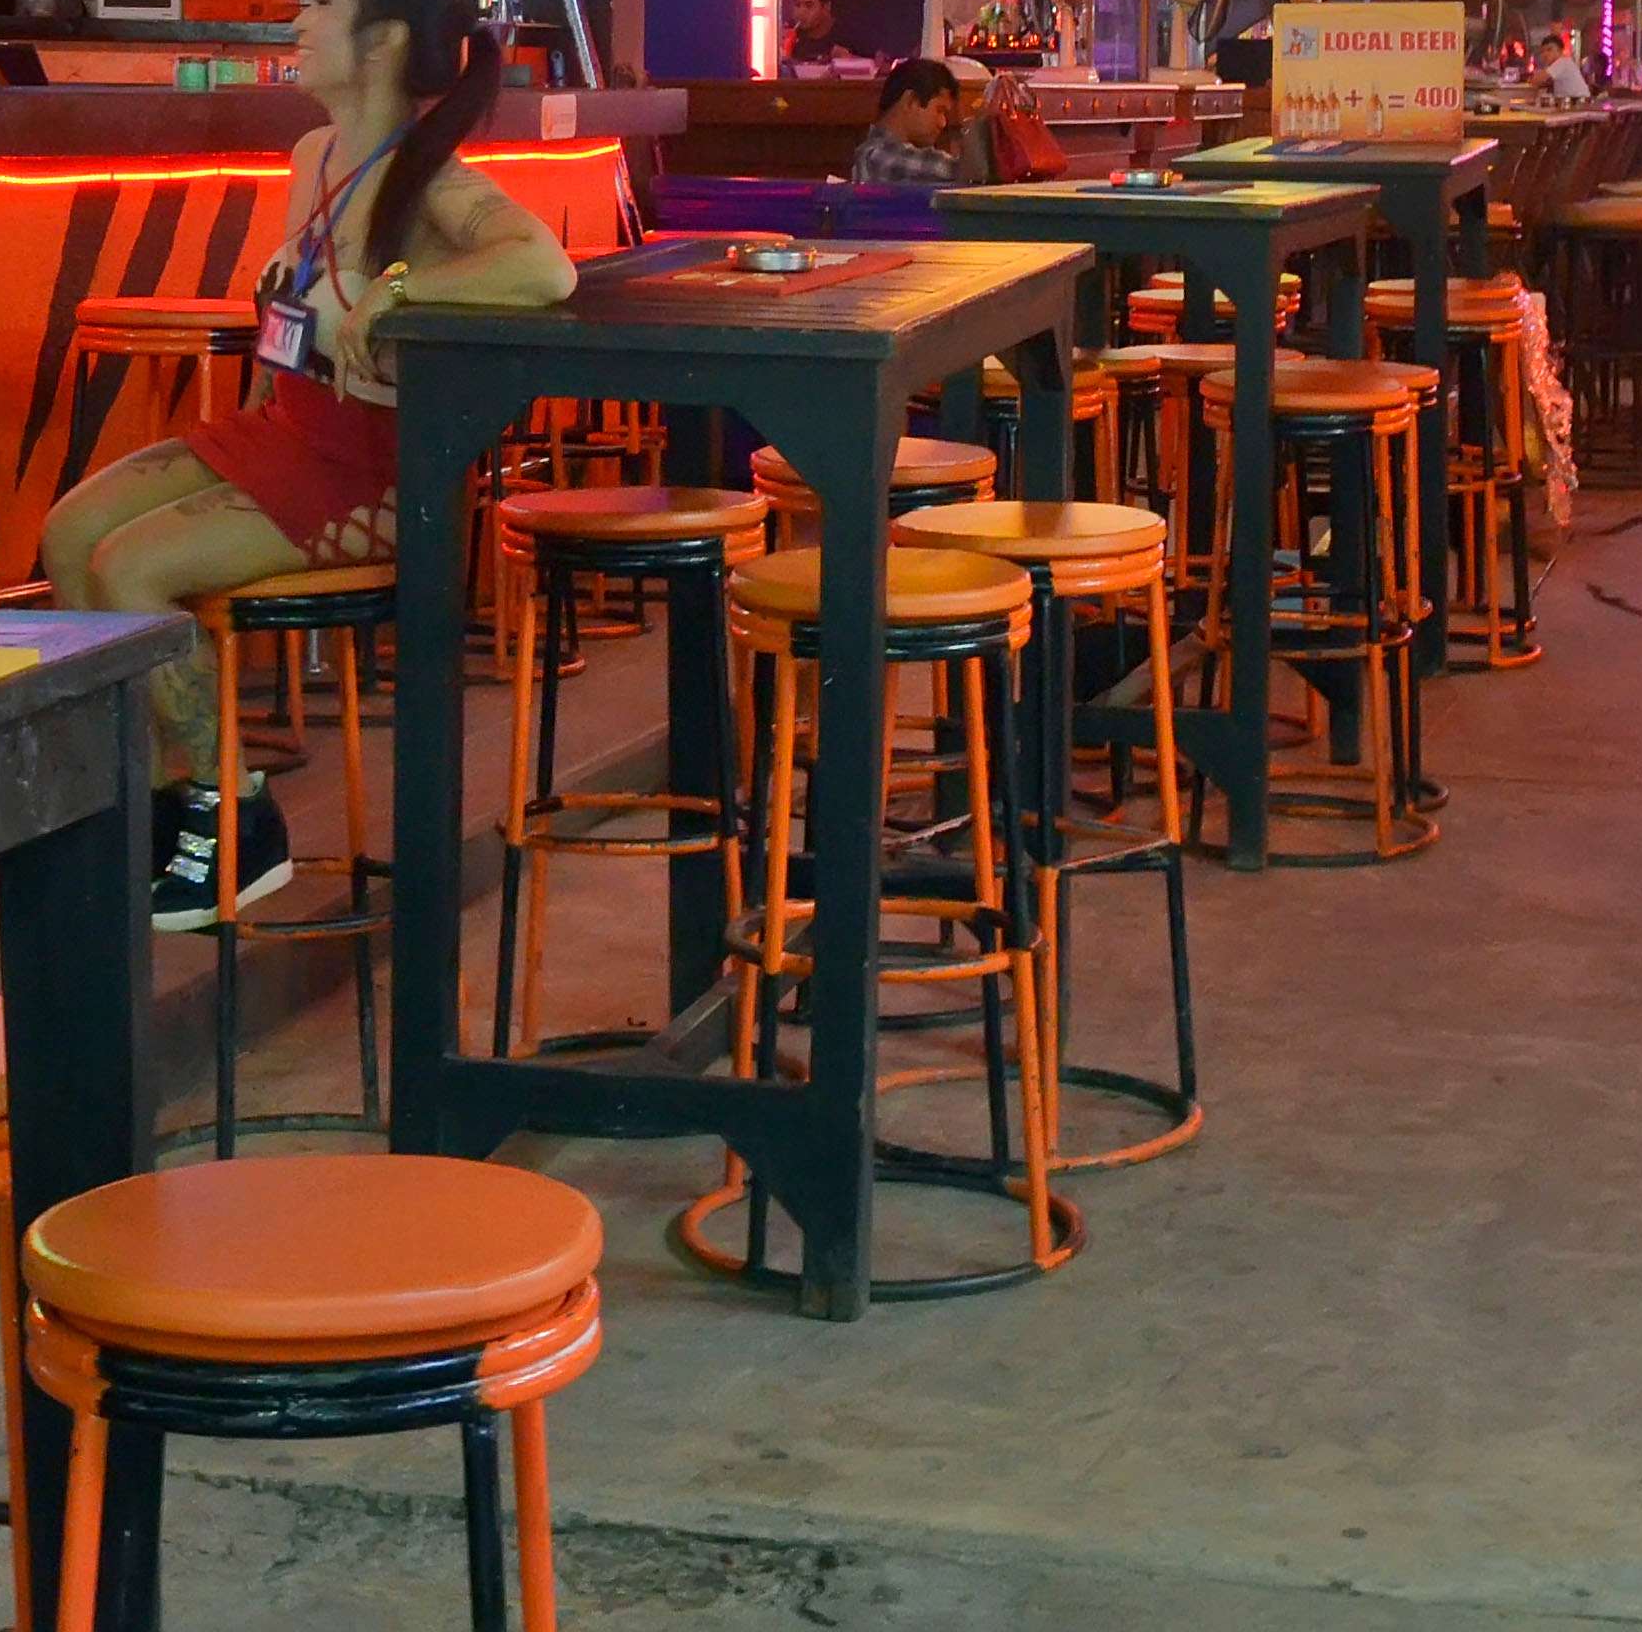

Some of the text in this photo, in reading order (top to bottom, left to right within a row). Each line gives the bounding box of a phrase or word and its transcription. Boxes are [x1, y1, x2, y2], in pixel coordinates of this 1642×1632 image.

[1323, 30, 1457, 52] LOCAL BEER
[1413, 86, 1458, 108] 400
